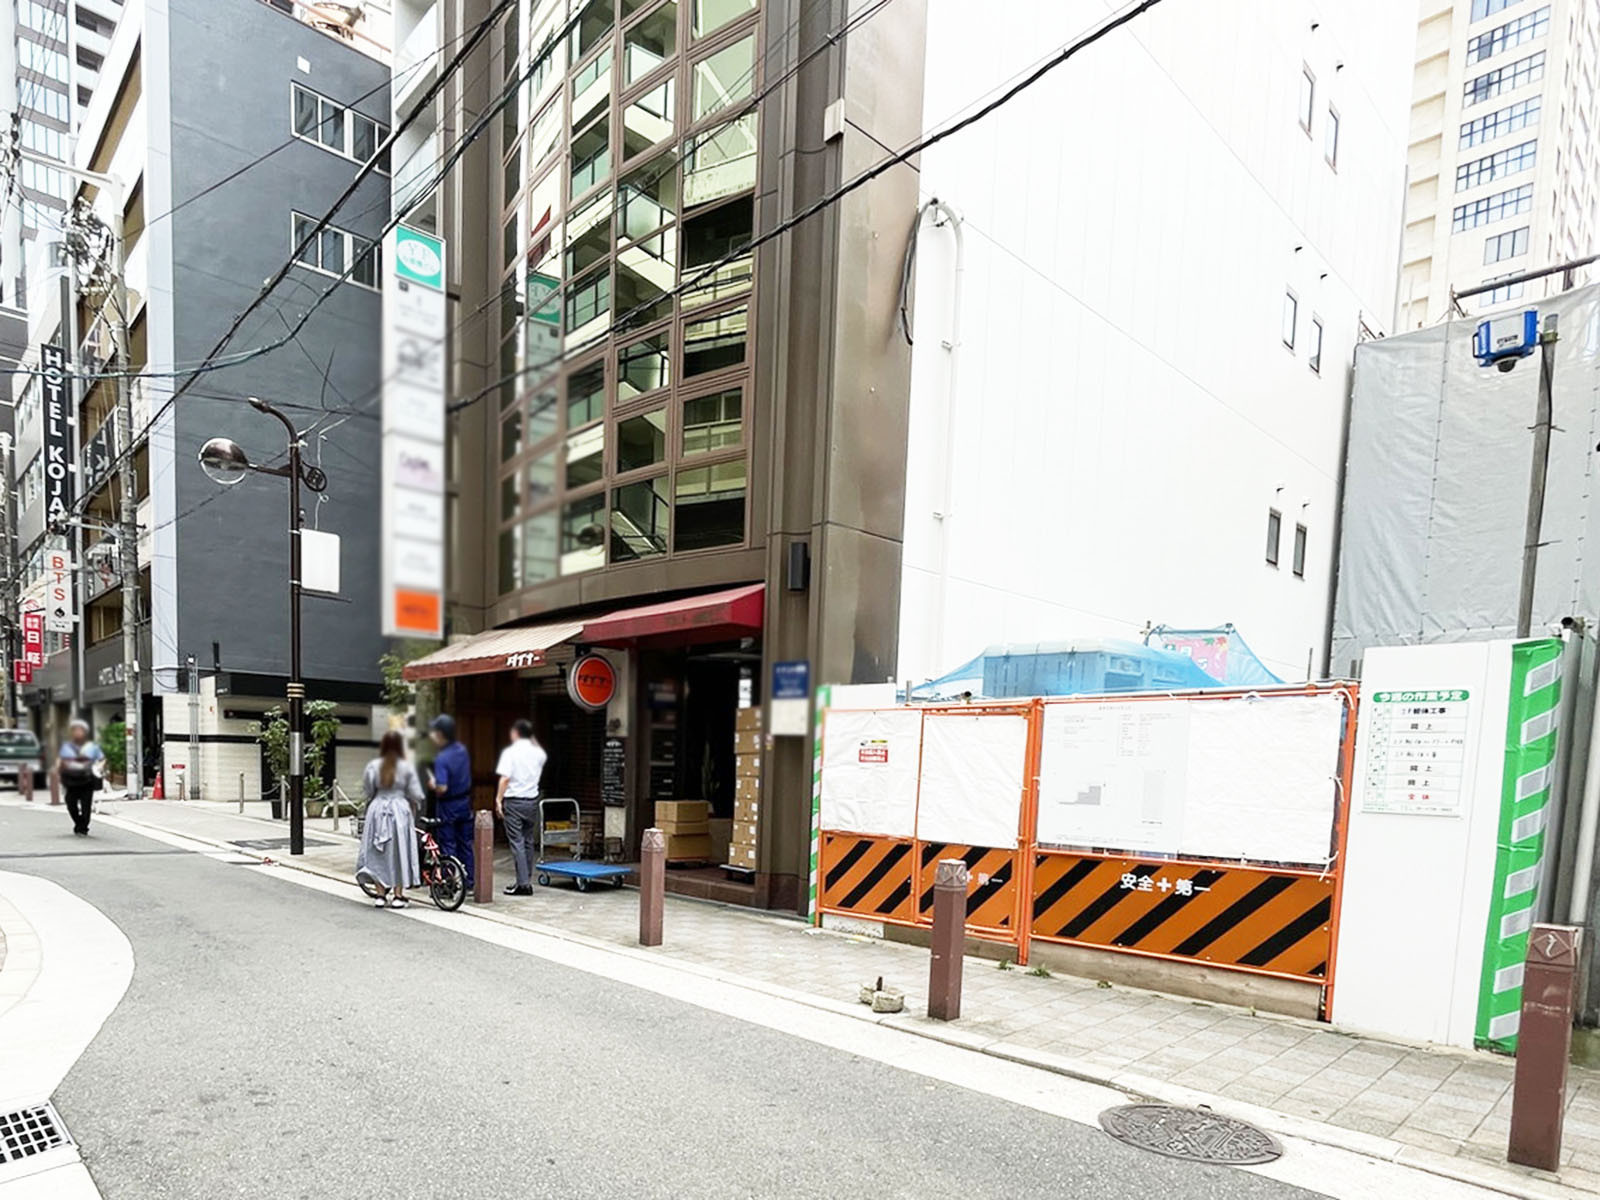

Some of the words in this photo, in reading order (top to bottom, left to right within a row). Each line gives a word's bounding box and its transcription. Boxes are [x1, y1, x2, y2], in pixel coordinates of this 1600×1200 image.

[45, 351, 64, 437] HOTEL
[52, 556, 66, 601] BTS
[1120, 873, 1154, 892] 安全
[1174, 877, 1211, 897] 第一
